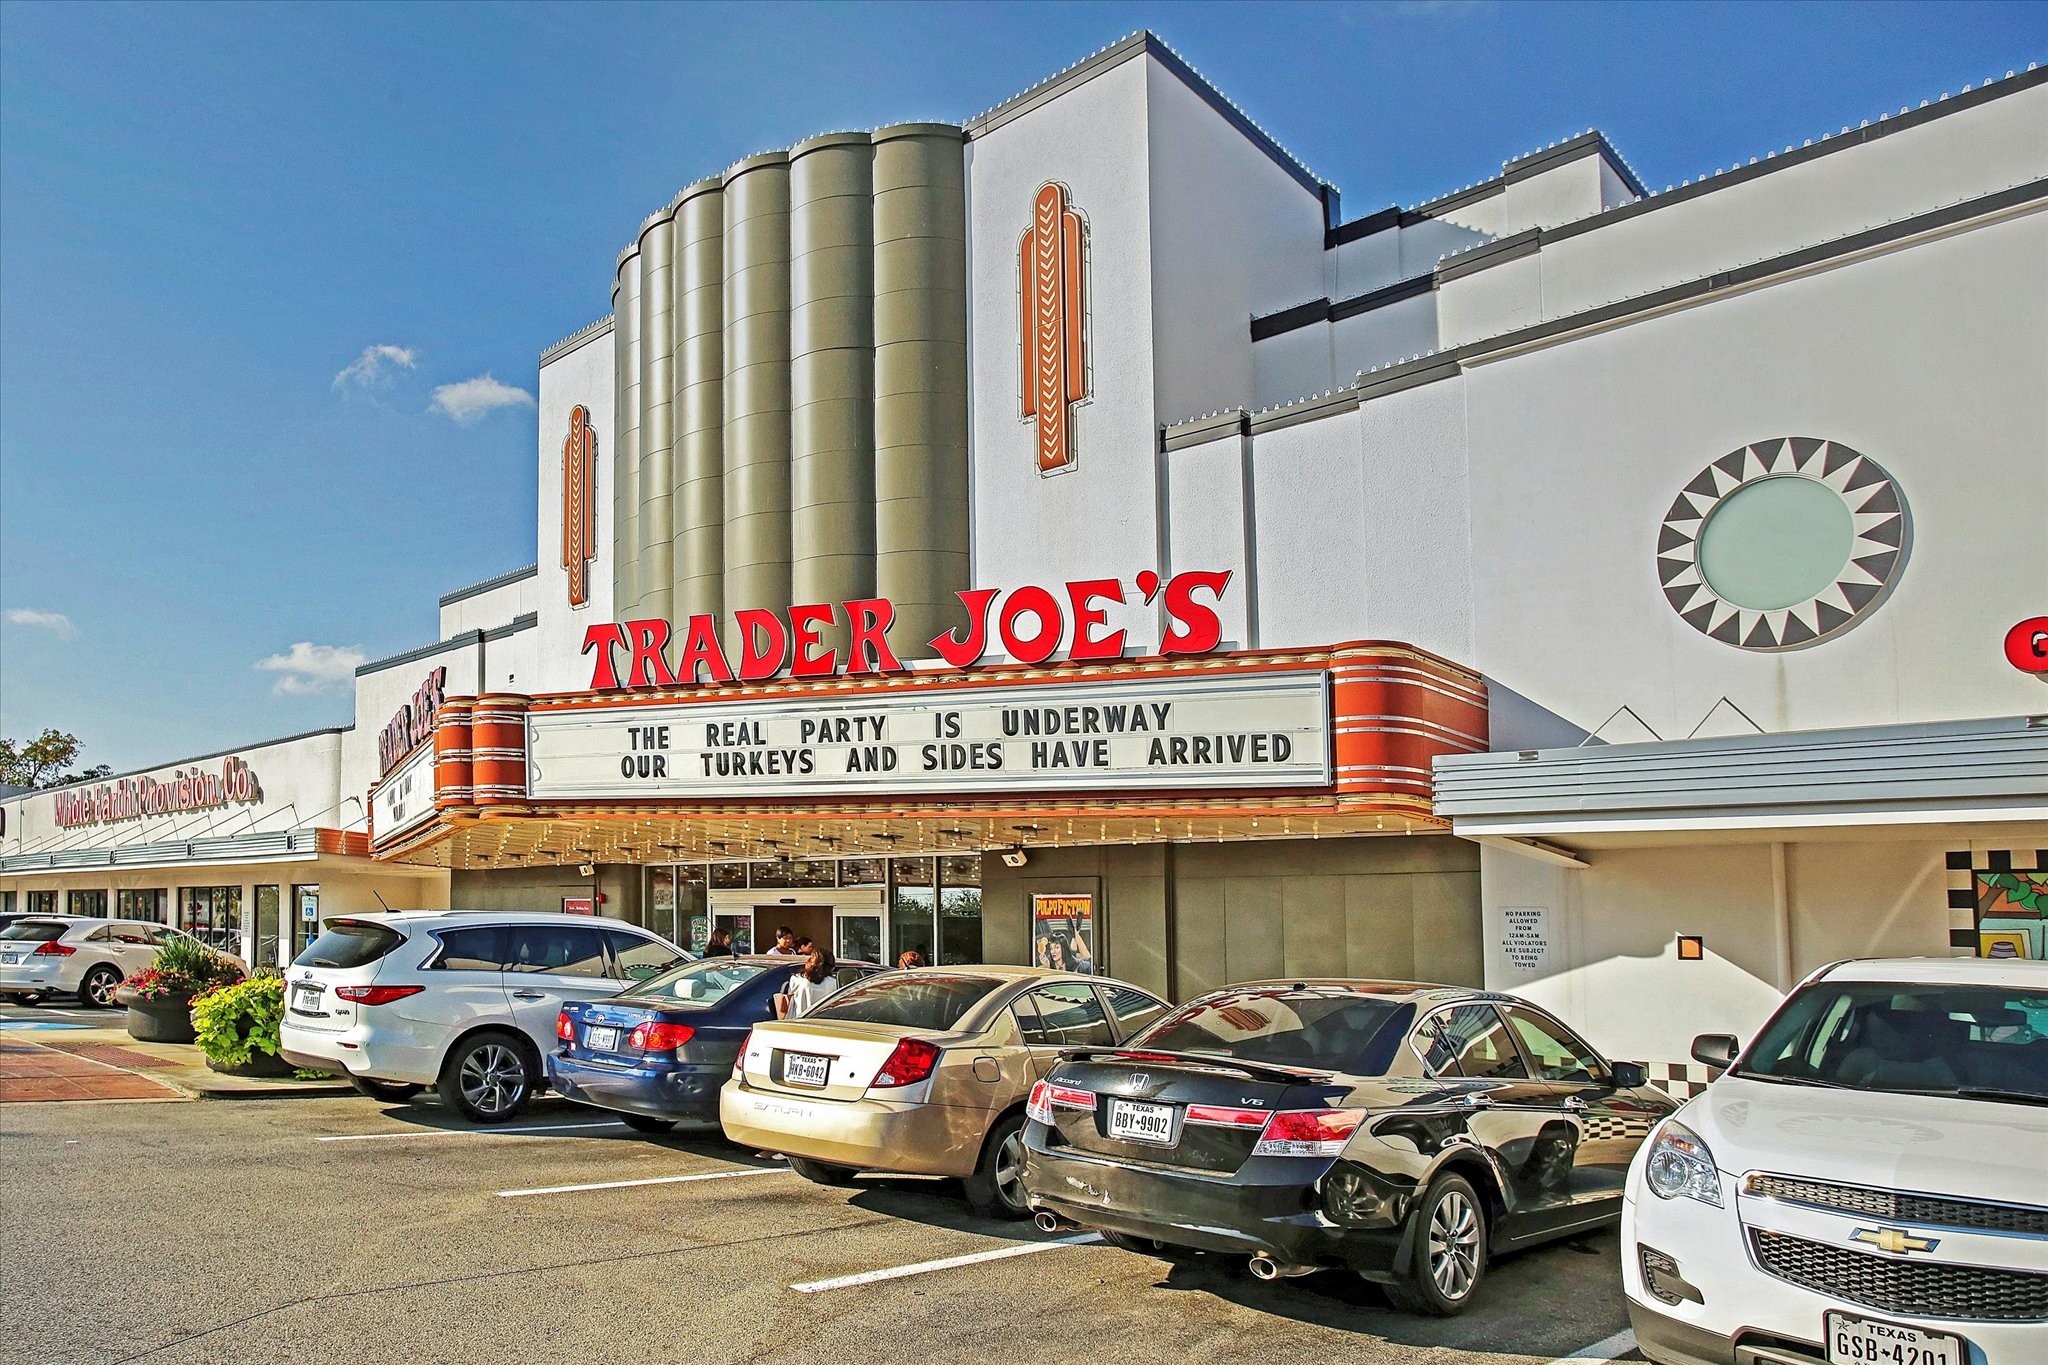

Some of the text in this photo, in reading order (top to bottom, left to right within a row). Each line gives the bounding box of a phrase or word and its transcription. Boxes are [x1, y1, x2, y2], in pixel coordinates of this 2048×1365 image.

[581, 569, 1233, 689] TRADER JOE'S
[628, 702, 1171, 750] THE REAL PARTY IS UNDERWAY
[621, 733, 1292, 778] OUR TURKEYS AND SIDES HAVE ARRIVED
[54, 756, 254, 827] Whole Earth Provision Co.
[801, 1056, 817, 1064] TEXAS
[1054, 1076, 1083, 1086] Accord
[1132, 1104, 1155, 1114] TEXAS
[1240, 1096, 1265, 1107] V6
[1867, 1324, 1917, 1343] TEXAS
